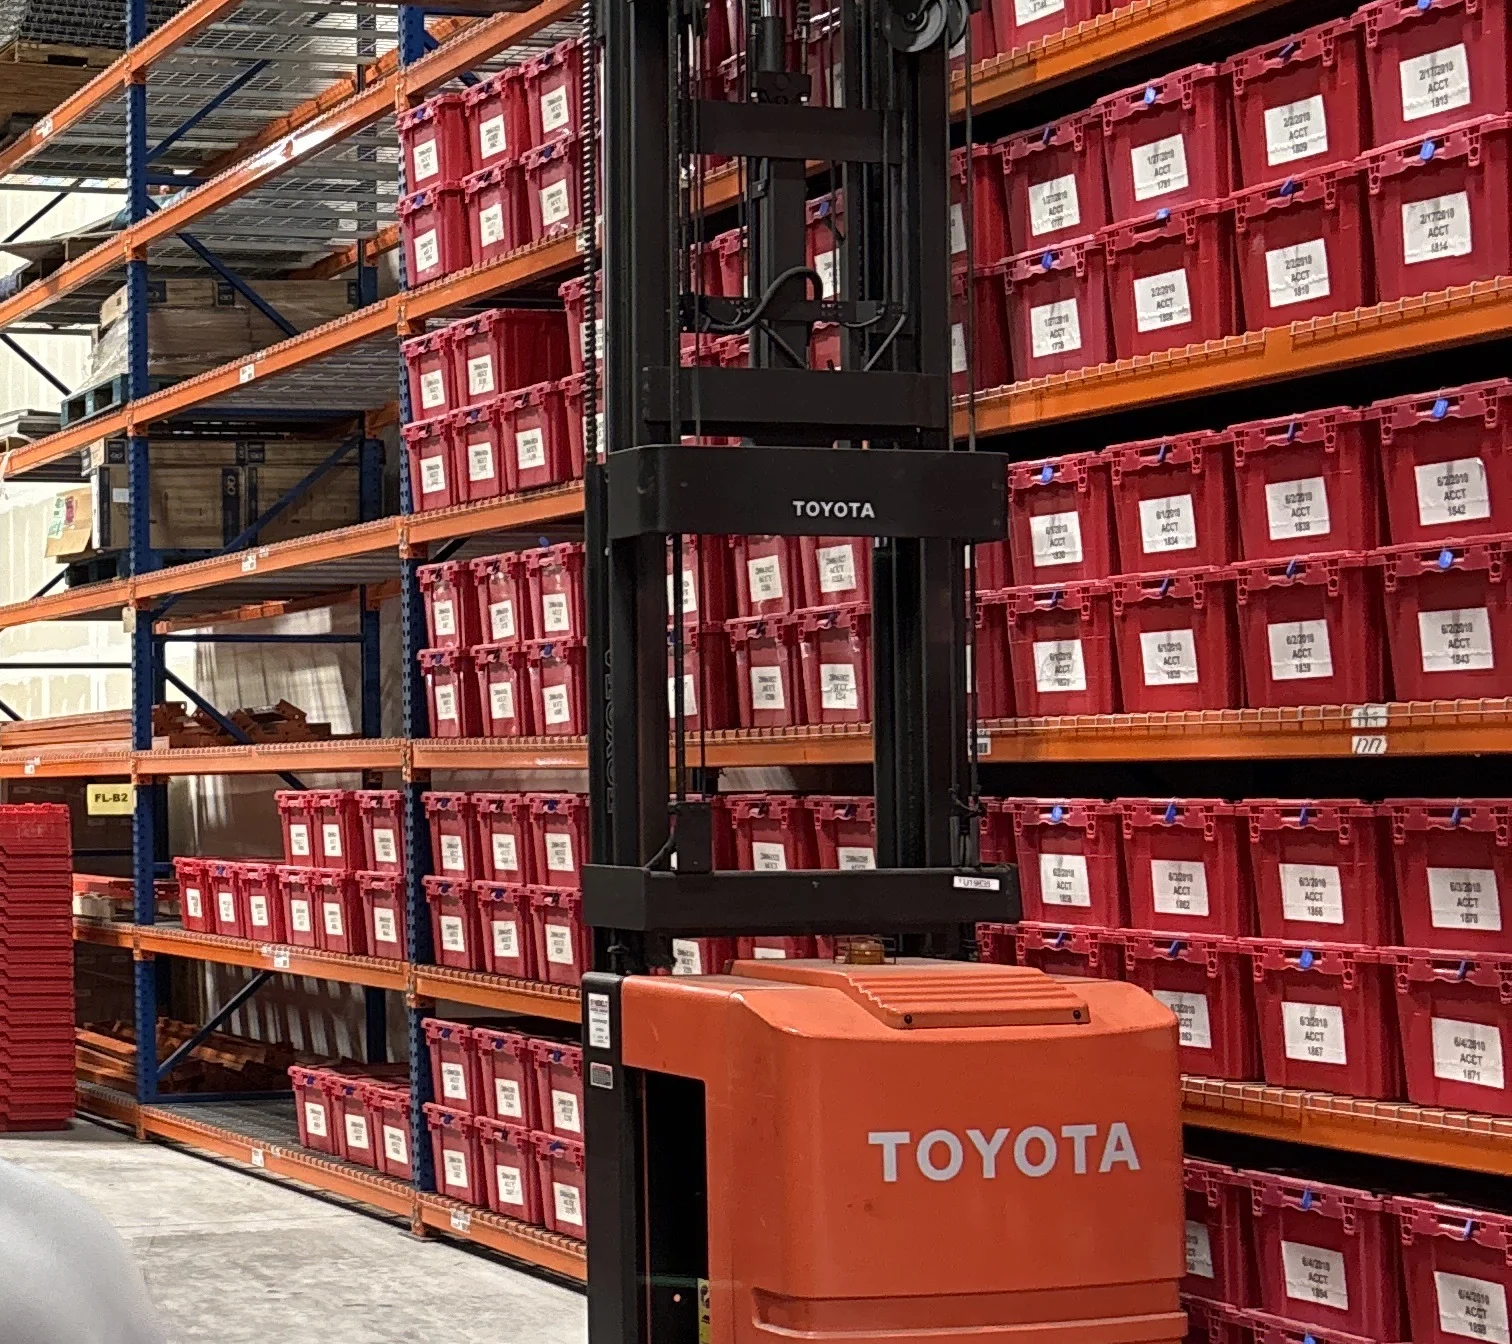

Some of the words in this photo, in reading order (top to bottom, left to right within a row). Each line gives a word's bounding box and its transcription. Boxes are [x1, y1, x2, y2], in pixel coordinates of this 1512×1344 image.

[1427, 78, 1449, 93] ACCT
[1288, 127, 1308, 140] ACCT
[1154, 164, 1171, 177] ACCT
[1048, 204, 1064, 216] ACCT
[1427, 224, 1449, 238] ACCT
[1291, 269, 1310, 282] ACCT
[1156, 297, 1174, 309] ACCT
[1049, 327, 1065, 339] ACCT
[1443, 488, 1466, 501] ACCT
[792, 500, 876, 519] TOYOTA
[1291, 506, 1311, 518] ACCT
[1161, 522, 1179, 533] ACCT
[1049, 537, 1066, 548] ACCT
[1448, 637, 1471, 649] ACCT
[1292, 648, 1312, 659] ACCT
[1163, 655, 1180, 666] ACCT
[1054, 664, 1071, 674] ACCT
[95, 793, 128, 803] FL-B2
[1056, 881, 1072, 890] ACCT
[1173, 886, 1191, 895] ACCT
[1304, 891, 1323, 902] ACCT
[1456, 897, 1479, 908] ACCT
[1304, 1031, 1325, 1042] ACCT
[1459, 1053, 1483, 1065] ACCT
[868, 1122, 1141, 1183] TOYOTA
[1308, 1272, 1328, 1284] ACCT
[1465, 1306, 1487, 1319] ACCT
